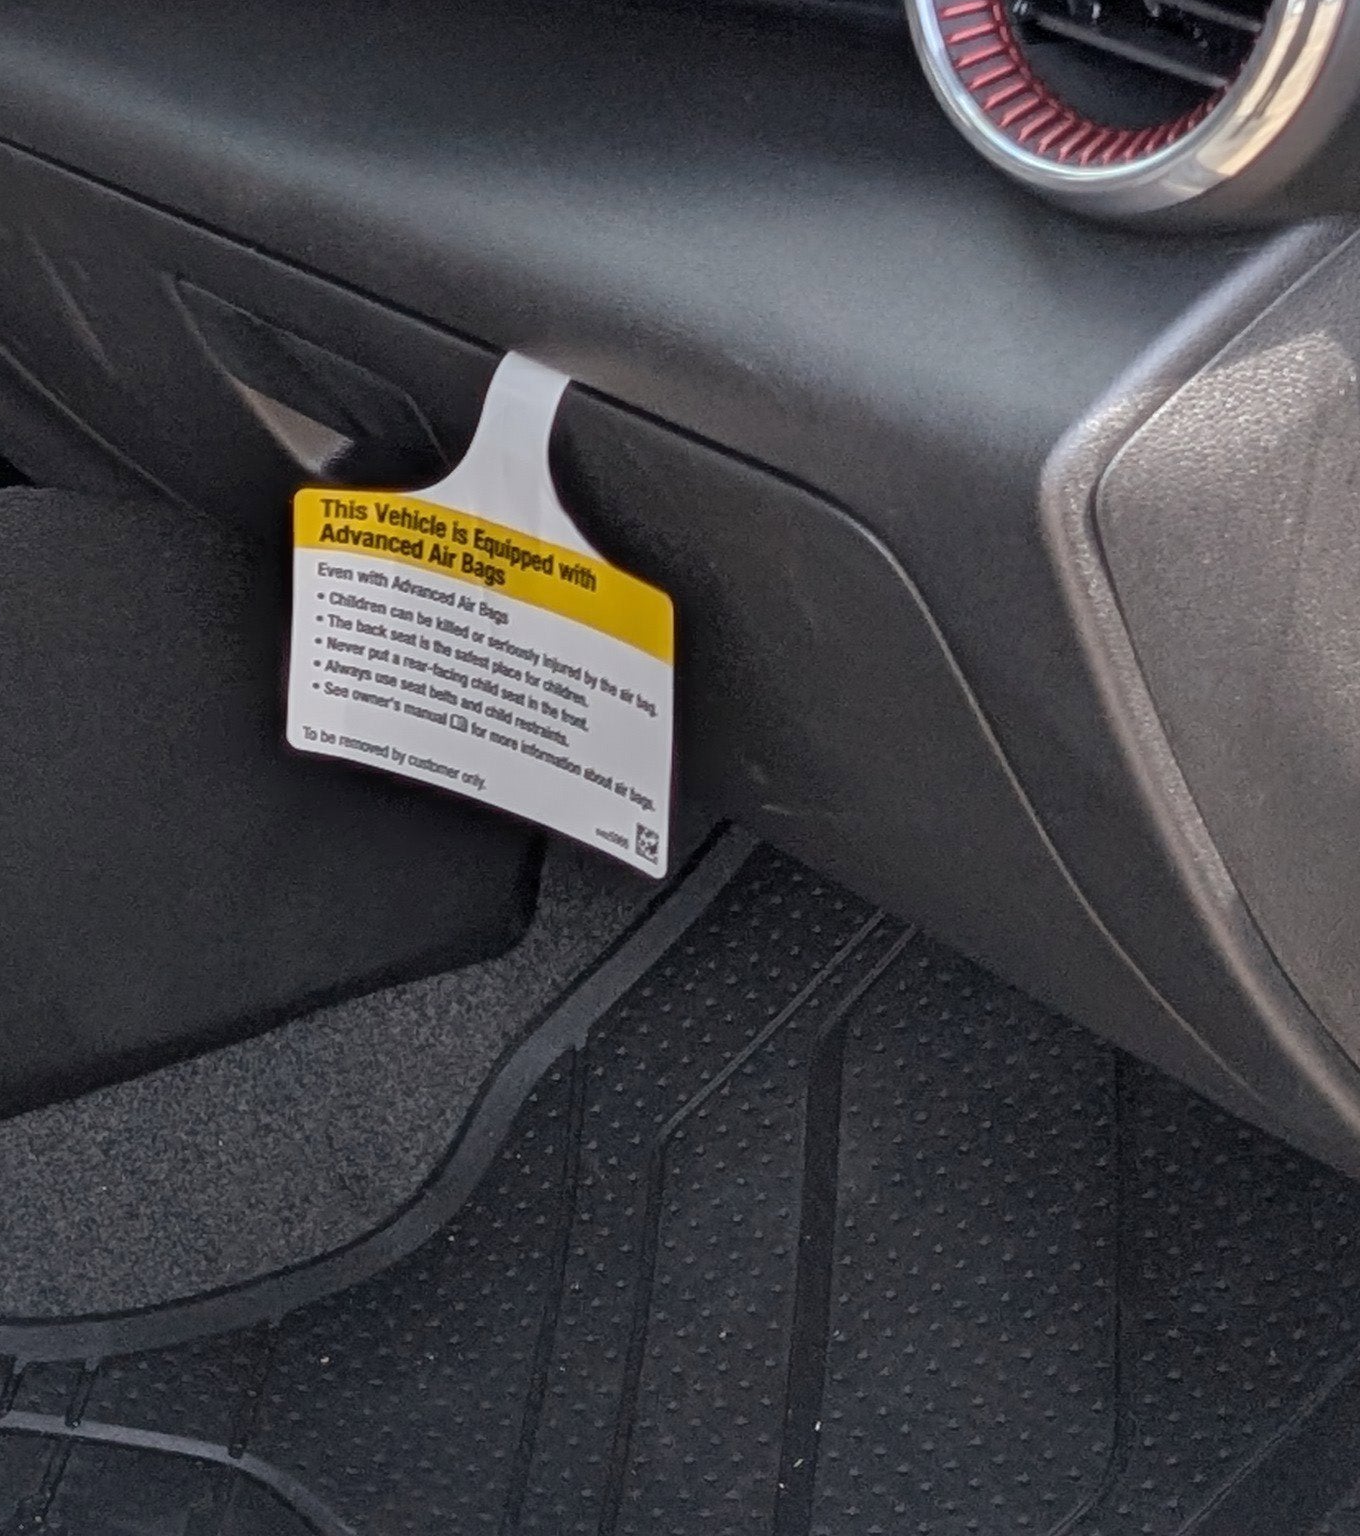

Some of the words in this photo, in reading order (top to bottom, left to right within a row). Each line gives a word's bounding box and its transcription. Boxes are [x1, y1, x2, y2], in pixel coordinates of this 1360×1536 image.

[319, 523, 424, 559] Advanced
[428, 543, 457, 569] Air
[461, 552, 506, 586] Bags
[320, 498, 368, 521] This
[374, 502, 447, 539] Vehicle
[451, 520, 469, 546] is
[473, 527, 555, 576] Equipped
[558, 562, 597, 592] with
[317, 562, 353, 580] Even
[357, 570, 389, 588] with
[391, 576, 455, 607] Advanced
[457, 595, 476, 613] Air
[479, 601, 509, 626] Bags
[324, 659, 372, 681] Always
[375, 673, 398, 687] use
[400, 679, 427, 696] seat
[429, 684, 458, 706] belts
[460, 697, 483, 714] and
[484, 705, 513, 725] child
[514, 716, 570, 747] restraints.
[326, 636, 365, 656] Never
[368, 648, 390, 662] put
[392, 653, 400, 665] a
[402, 656, 469, 688] rear-facing
[471, 677, 499, 696] child
[501, 688, 525, 706] seat
[527, 695, 539, 710] in
[541, 700, 559, 719] the
[561, 708, 589, 732] front.
[327, 613, 353, 631] The
[356, 619, 387, 638] back
[390, 630, 417, 647] seat
[419, 634, 430, 651] is
[433, 639, 452, 657] the
[454, 648, 490, 670] safest
[491, 661, 522, 681] place
[524, 670, 541, 687] for
[542, 679, 589, 708] children.
[302, 725, 318, 741] To
[320, 730, 336, 745] be
[338, 735, 390, 759] removed
[391, 747, 407, 765] by
[407, 755, 460, 779] customer
[461, 772, 487, 791] only.
